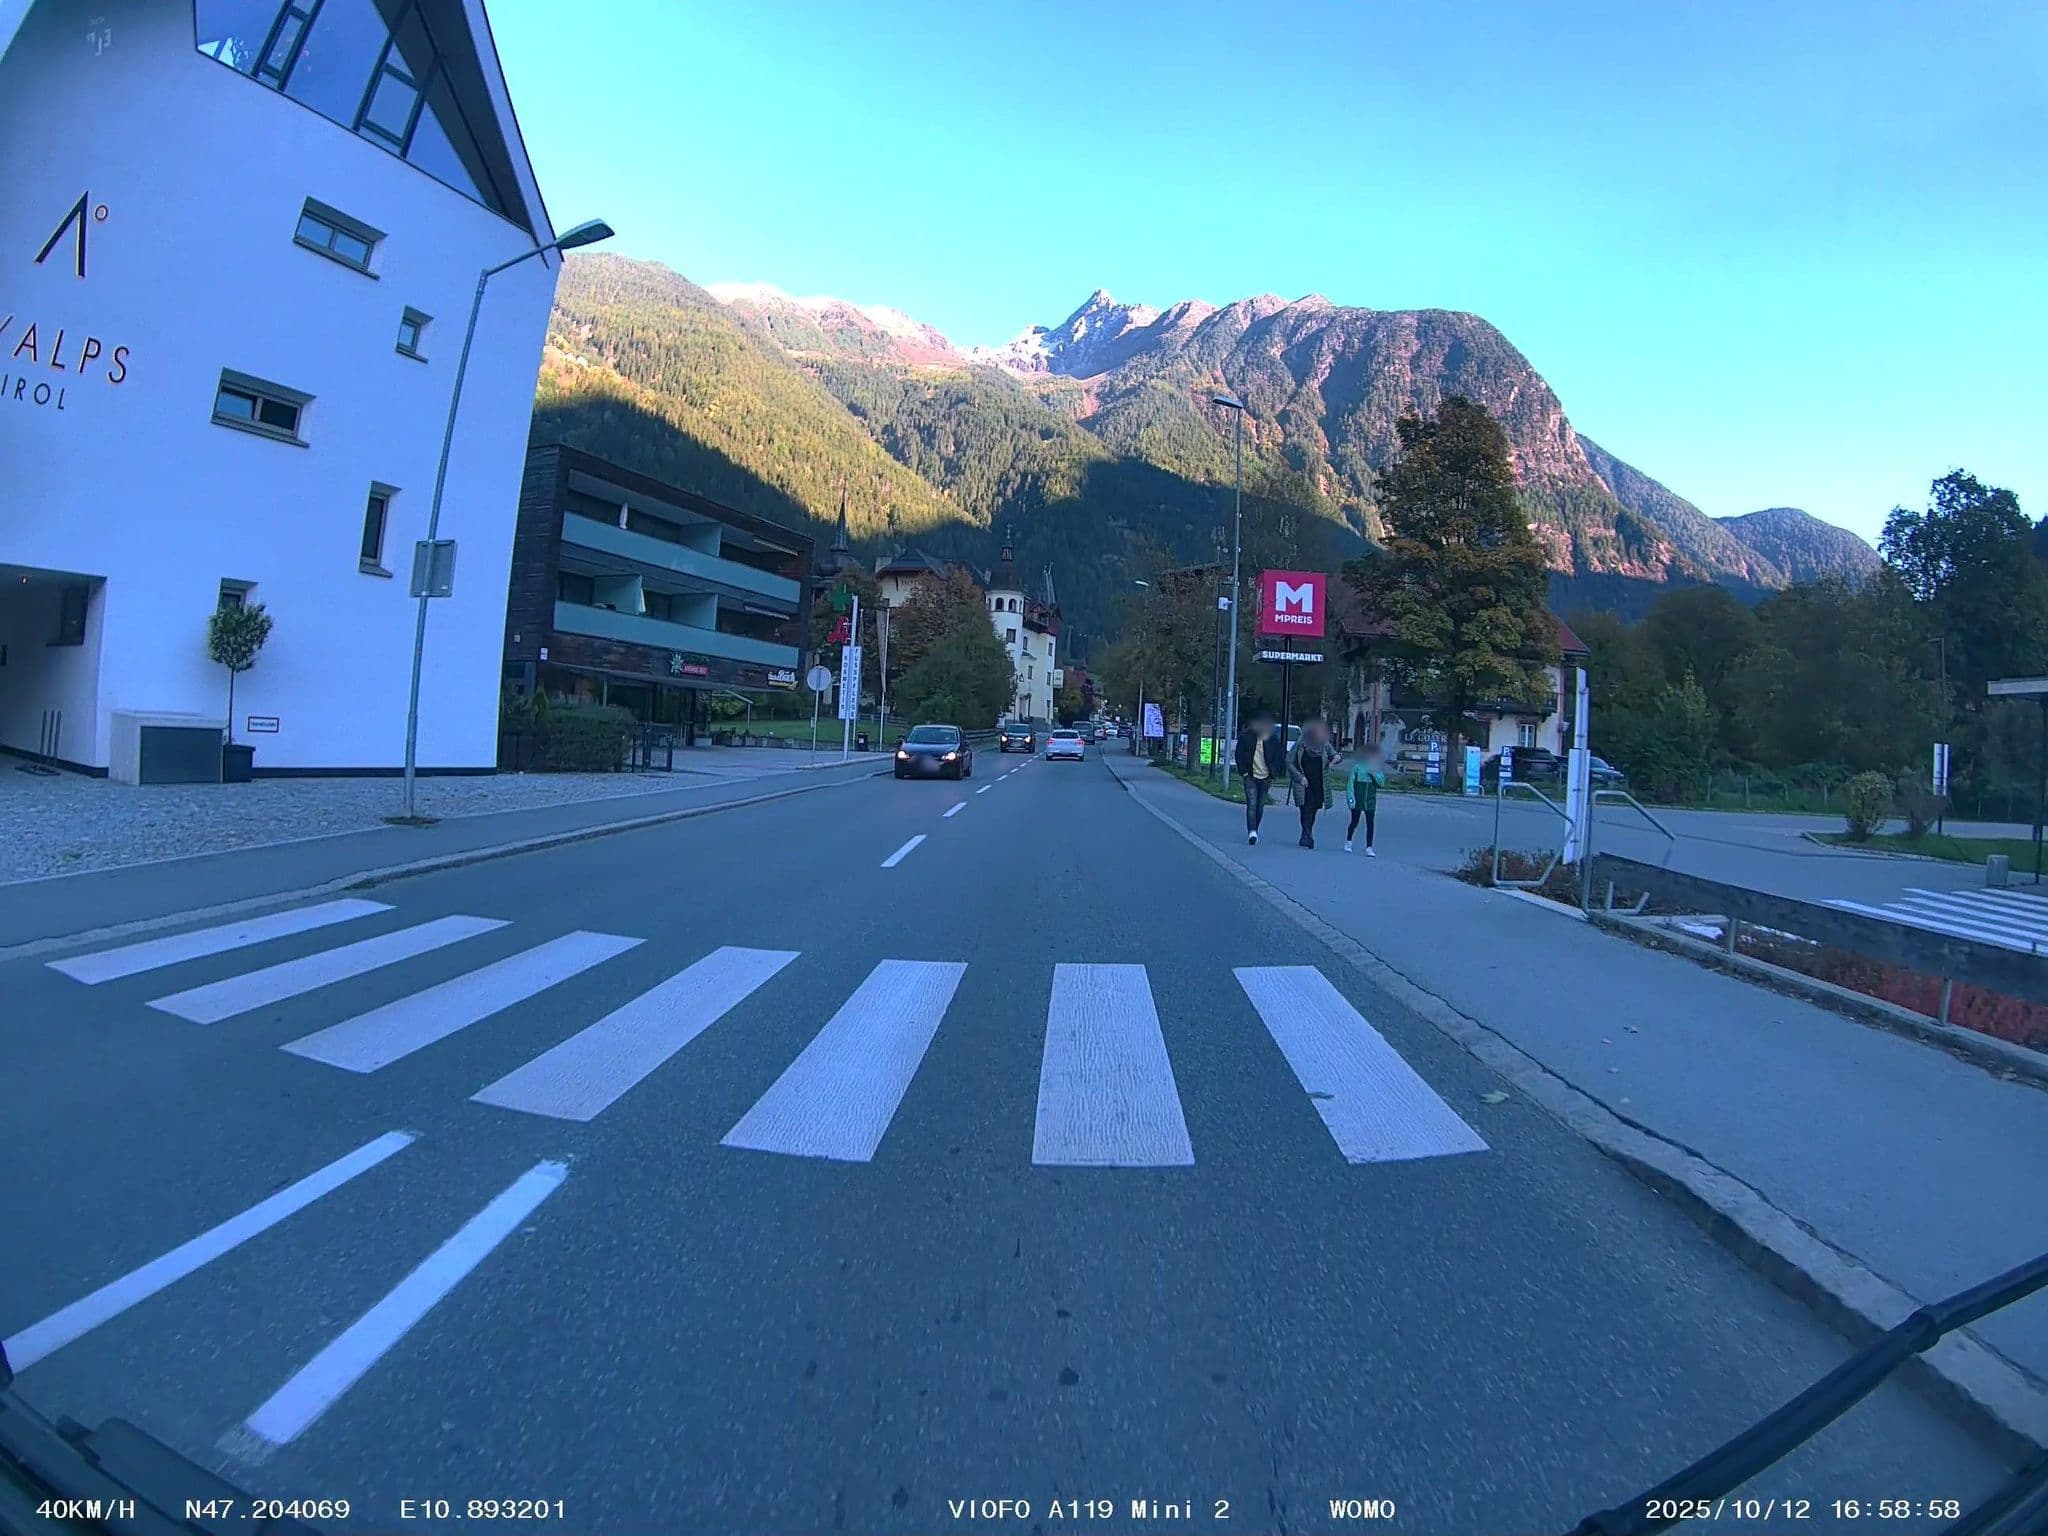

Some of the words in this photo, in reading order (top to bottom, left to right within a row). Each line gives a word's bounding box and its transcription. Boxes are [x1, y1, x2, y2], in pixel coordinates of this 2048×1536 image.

[1275, 581, 1314, 613] M
[1275, 614, 1313, 625] MPREIS
[1262, 650, 1324, 662] SUPERMARKT
